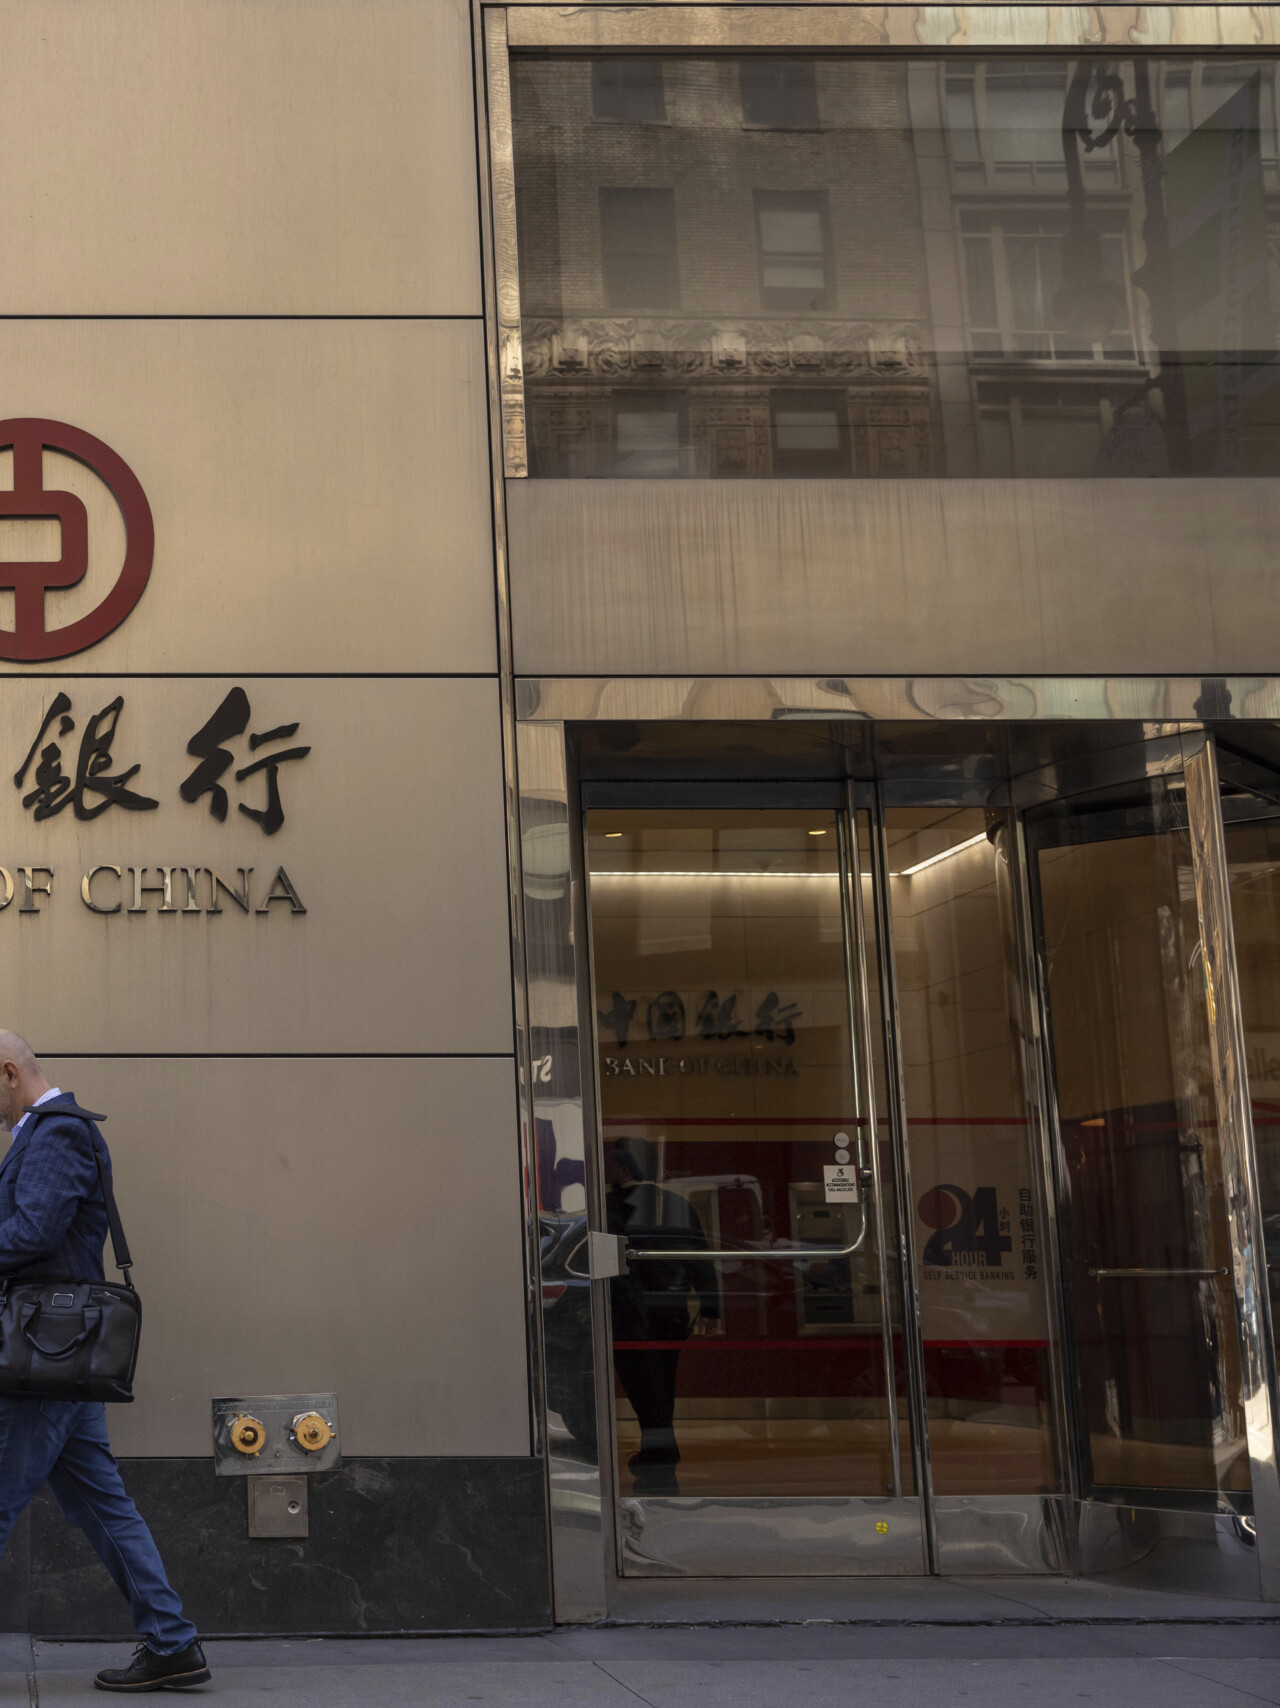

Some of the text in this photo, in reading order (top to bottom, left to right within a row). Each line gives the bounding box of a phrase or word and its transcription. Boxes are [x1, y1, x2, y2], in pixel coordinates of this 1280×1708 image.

[81, 864, 308, 913] CHINA
[605, 1058, 669, 1076] BANK
[918, 1184, 1012, 1266] 24
[999, 1207, 1011, 1234] 小时
[1018, 1187, 1038, 1280] 自助银行服务
[952, 1251, 987, 1267] HOUR
[923, 1271, 1015, 1281] SELF SERVICE BANKING
